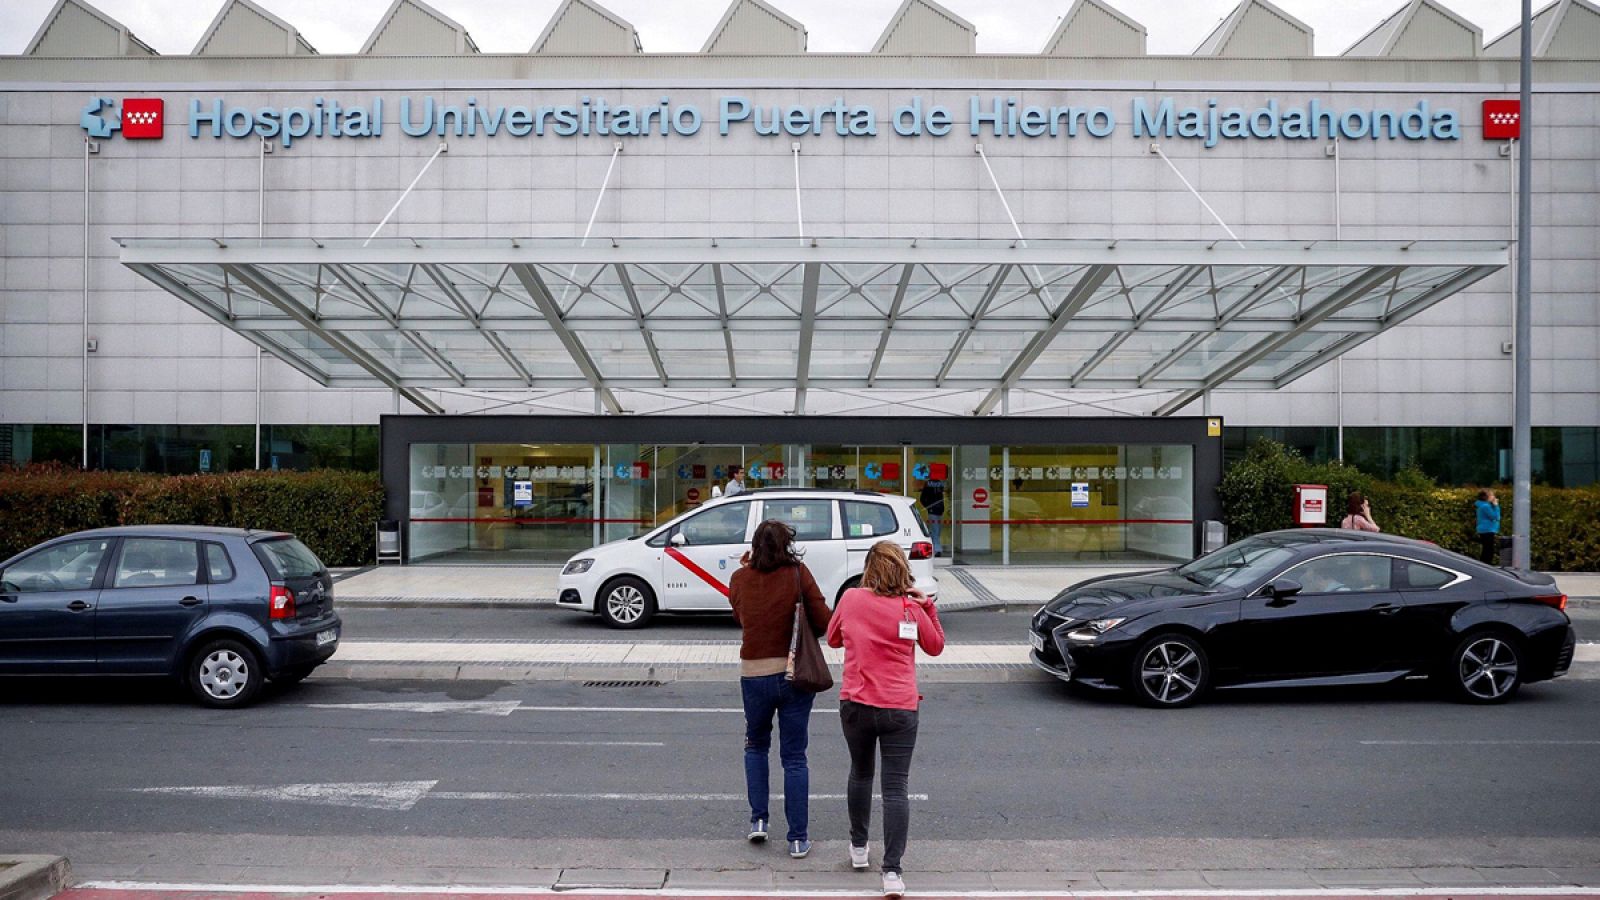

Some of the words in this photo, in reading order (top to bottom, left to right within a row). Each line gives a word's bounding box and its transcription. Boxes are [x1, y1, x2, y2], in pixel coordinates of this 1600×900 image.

[188, 96, 384, 149] Hospital
[400, 96, 703, 137] Universitario
[719, 96, 877, 137] Puerta
[892, 96, 953, 137] de
[969, 96, 1116, 138] Hierro
[1132, 97, 1462, 148] Majadahonda
[903, 527, 912, 537] M
